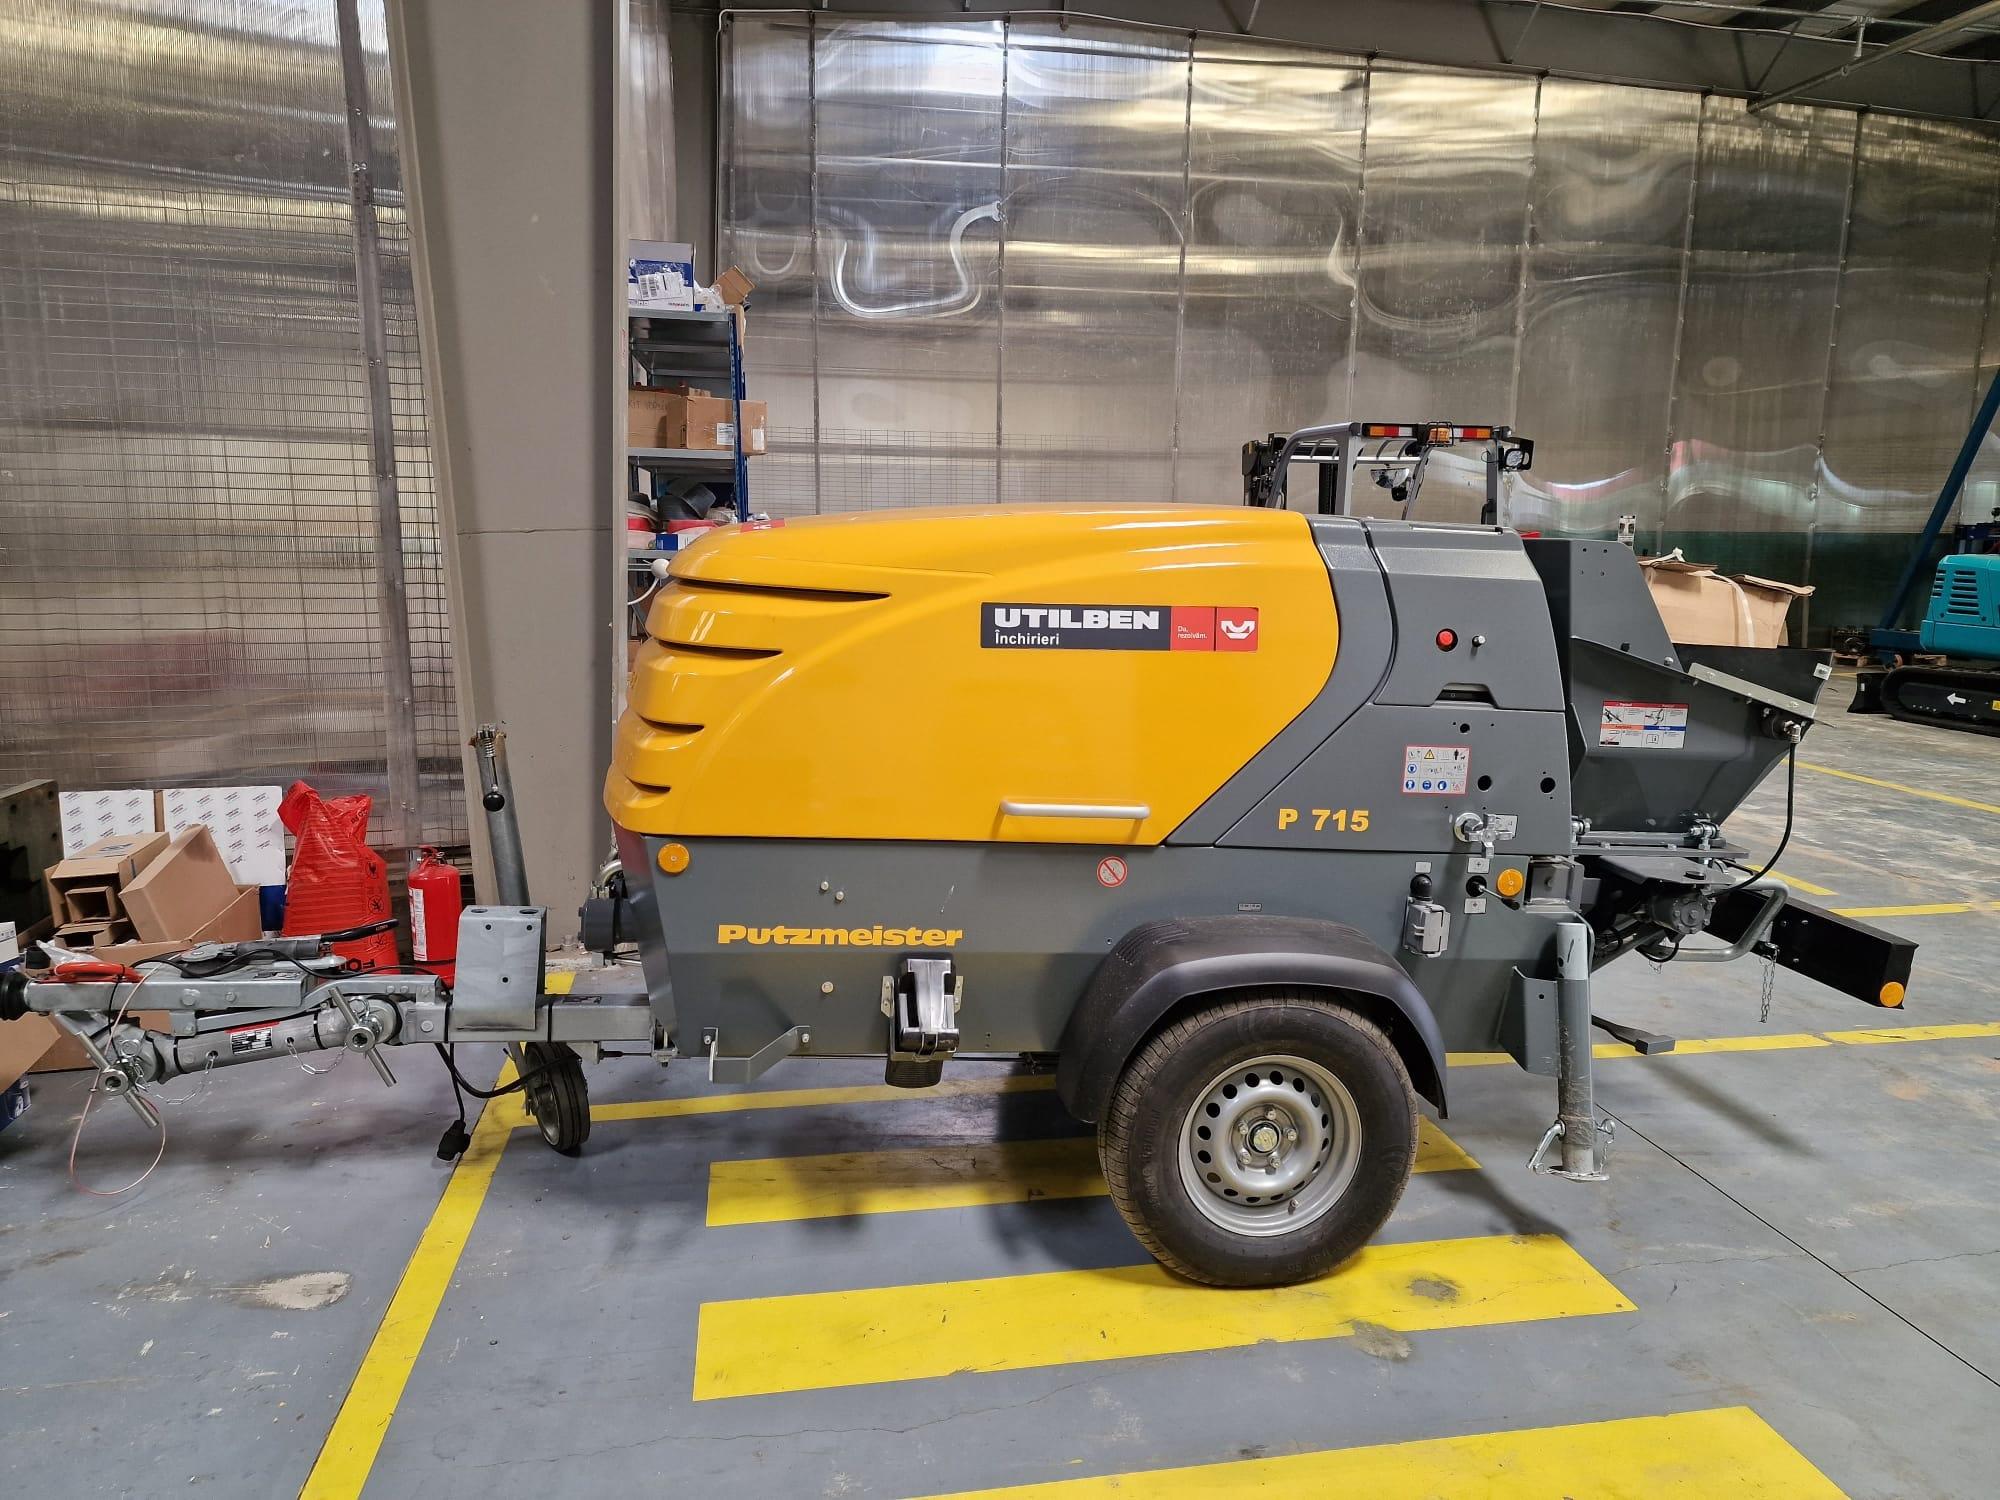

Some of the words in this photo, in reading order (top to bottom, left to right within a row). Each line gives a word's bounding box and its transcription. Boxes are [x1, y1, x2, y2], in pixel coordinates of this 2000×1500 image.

[994, 607, 1160, 630] UTILBEN
[995, 629, 1060, 646] Închirieri
[1278, 808, 1299, 830] P
[1311, 808, 1370, 833] 715
[717, 924, 963, 946] Putzmeister
